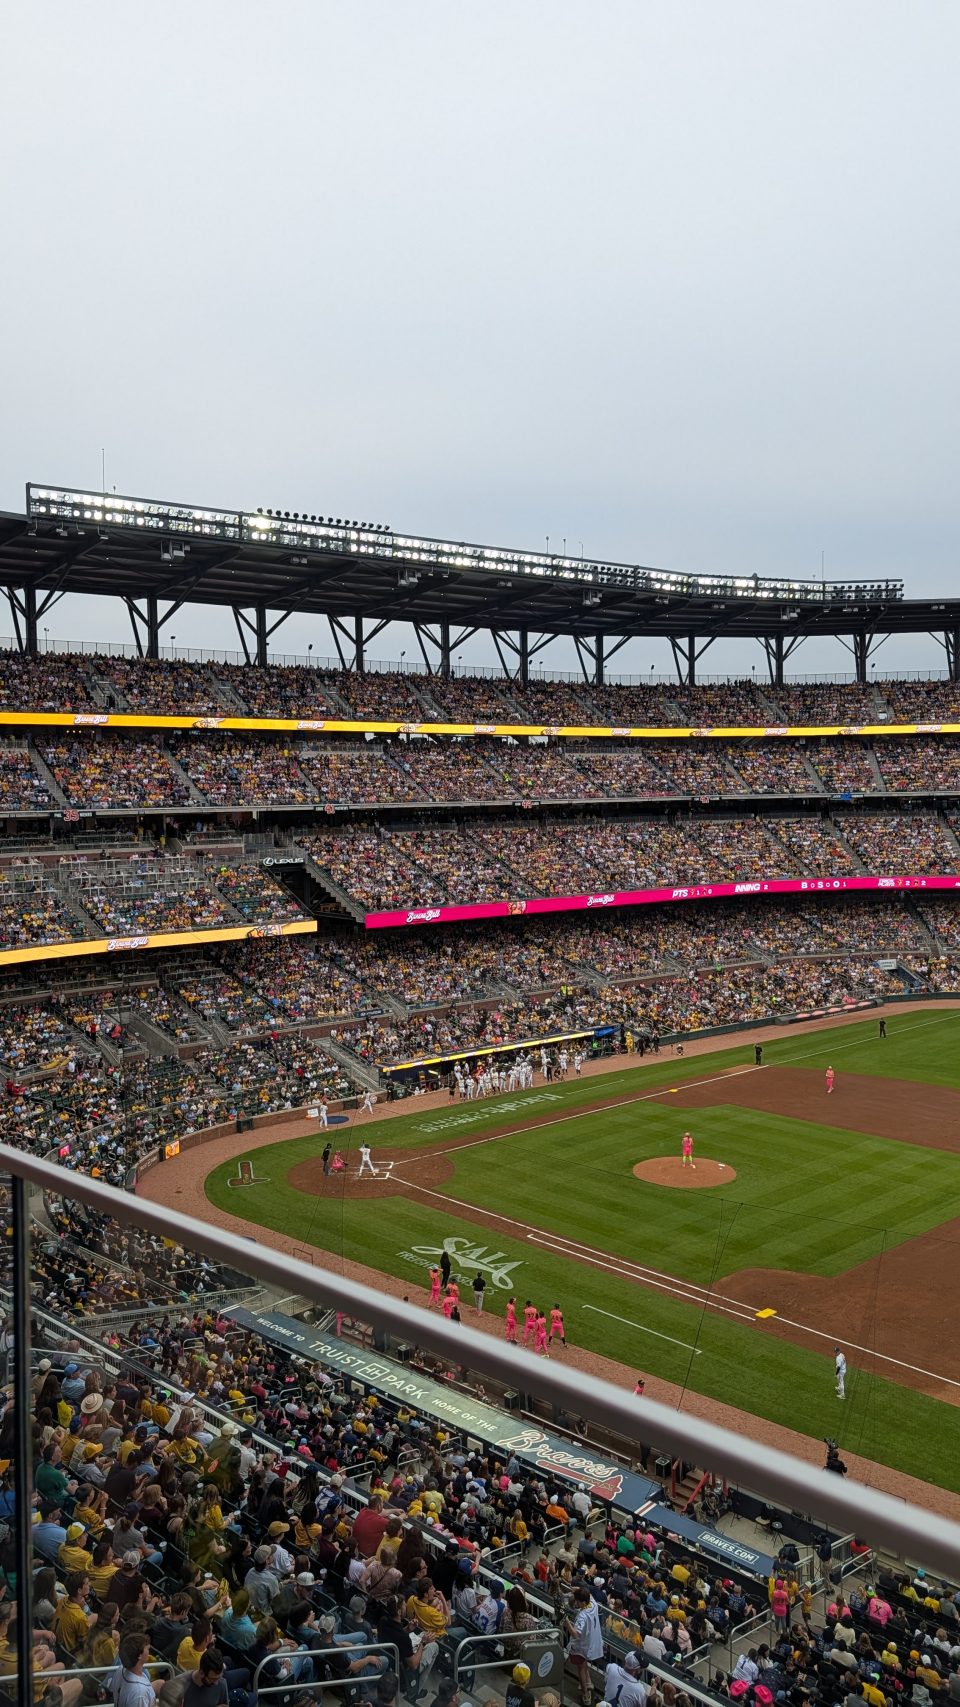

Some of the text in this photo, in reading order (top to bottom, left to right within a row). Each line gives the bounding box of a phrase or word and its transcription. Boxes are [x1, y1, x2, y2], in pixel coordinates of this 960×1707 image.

[63, 809, 80, 822] 35
[274, 857, 304, 865] LEXUS
[672, 889, 689, 898] PTS
[735, 883, 761, 893] INNING
[801, 881, 808, 889] B
[817, 881, 824, 889] S
[411, 1237, 525, 1290] SAIA
[256, 1317, 306, 1342] WELCOME TO
[308, 1340, 429, 1400] TRUIST PARK
[431, 1397, 498, 1433] HOME OF THE
[497, 1428, 618, 1478] Braves
[702, 1533, 756, 1562] BRAVES.COM
[873, 1605, 882, 1615] X
